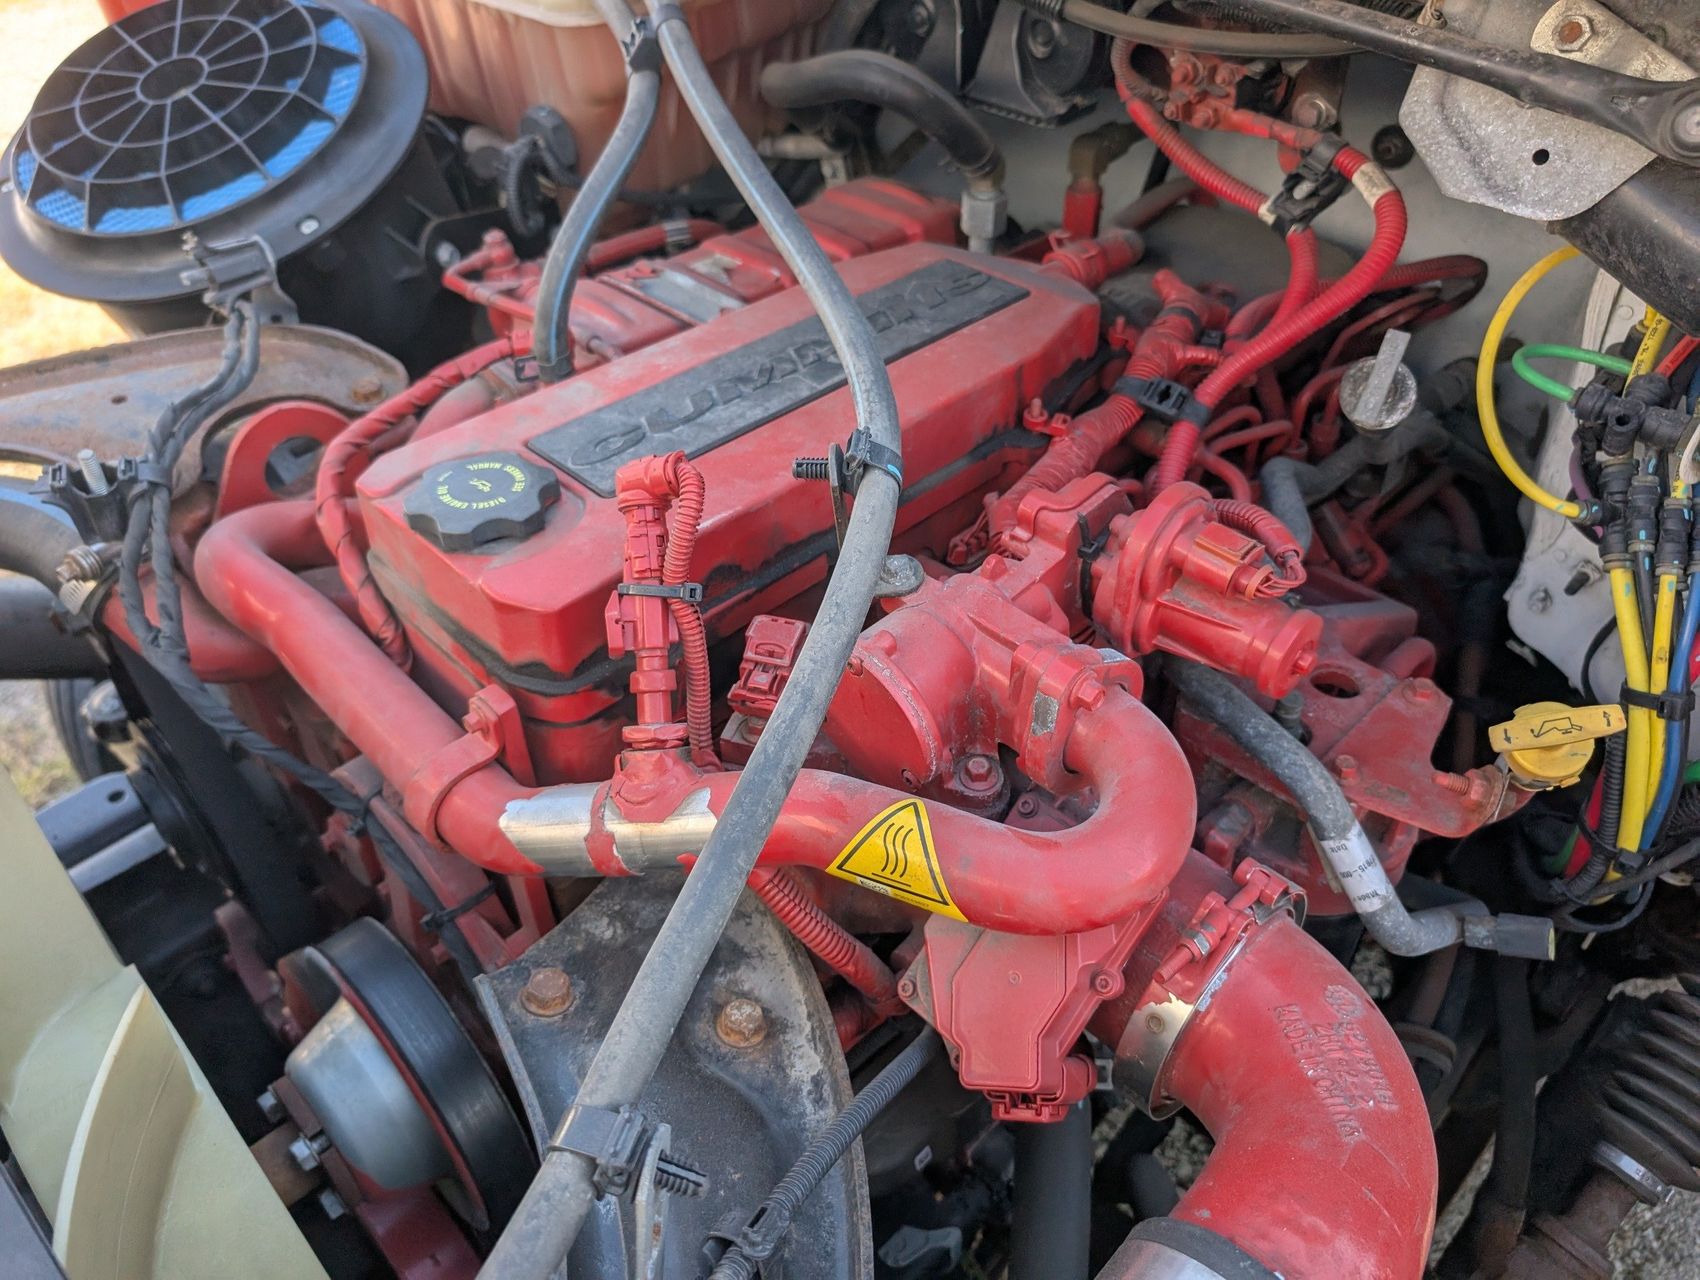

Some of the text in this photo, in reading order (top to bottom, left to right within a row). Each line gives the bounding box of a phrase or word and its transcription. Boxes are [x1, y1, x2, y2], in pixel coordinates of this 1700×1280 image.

[465, 462, 502, 471] MANUAL
[437, 494, 469, 510] ENGINE
[470, 496, 507, 510] DIESEL
